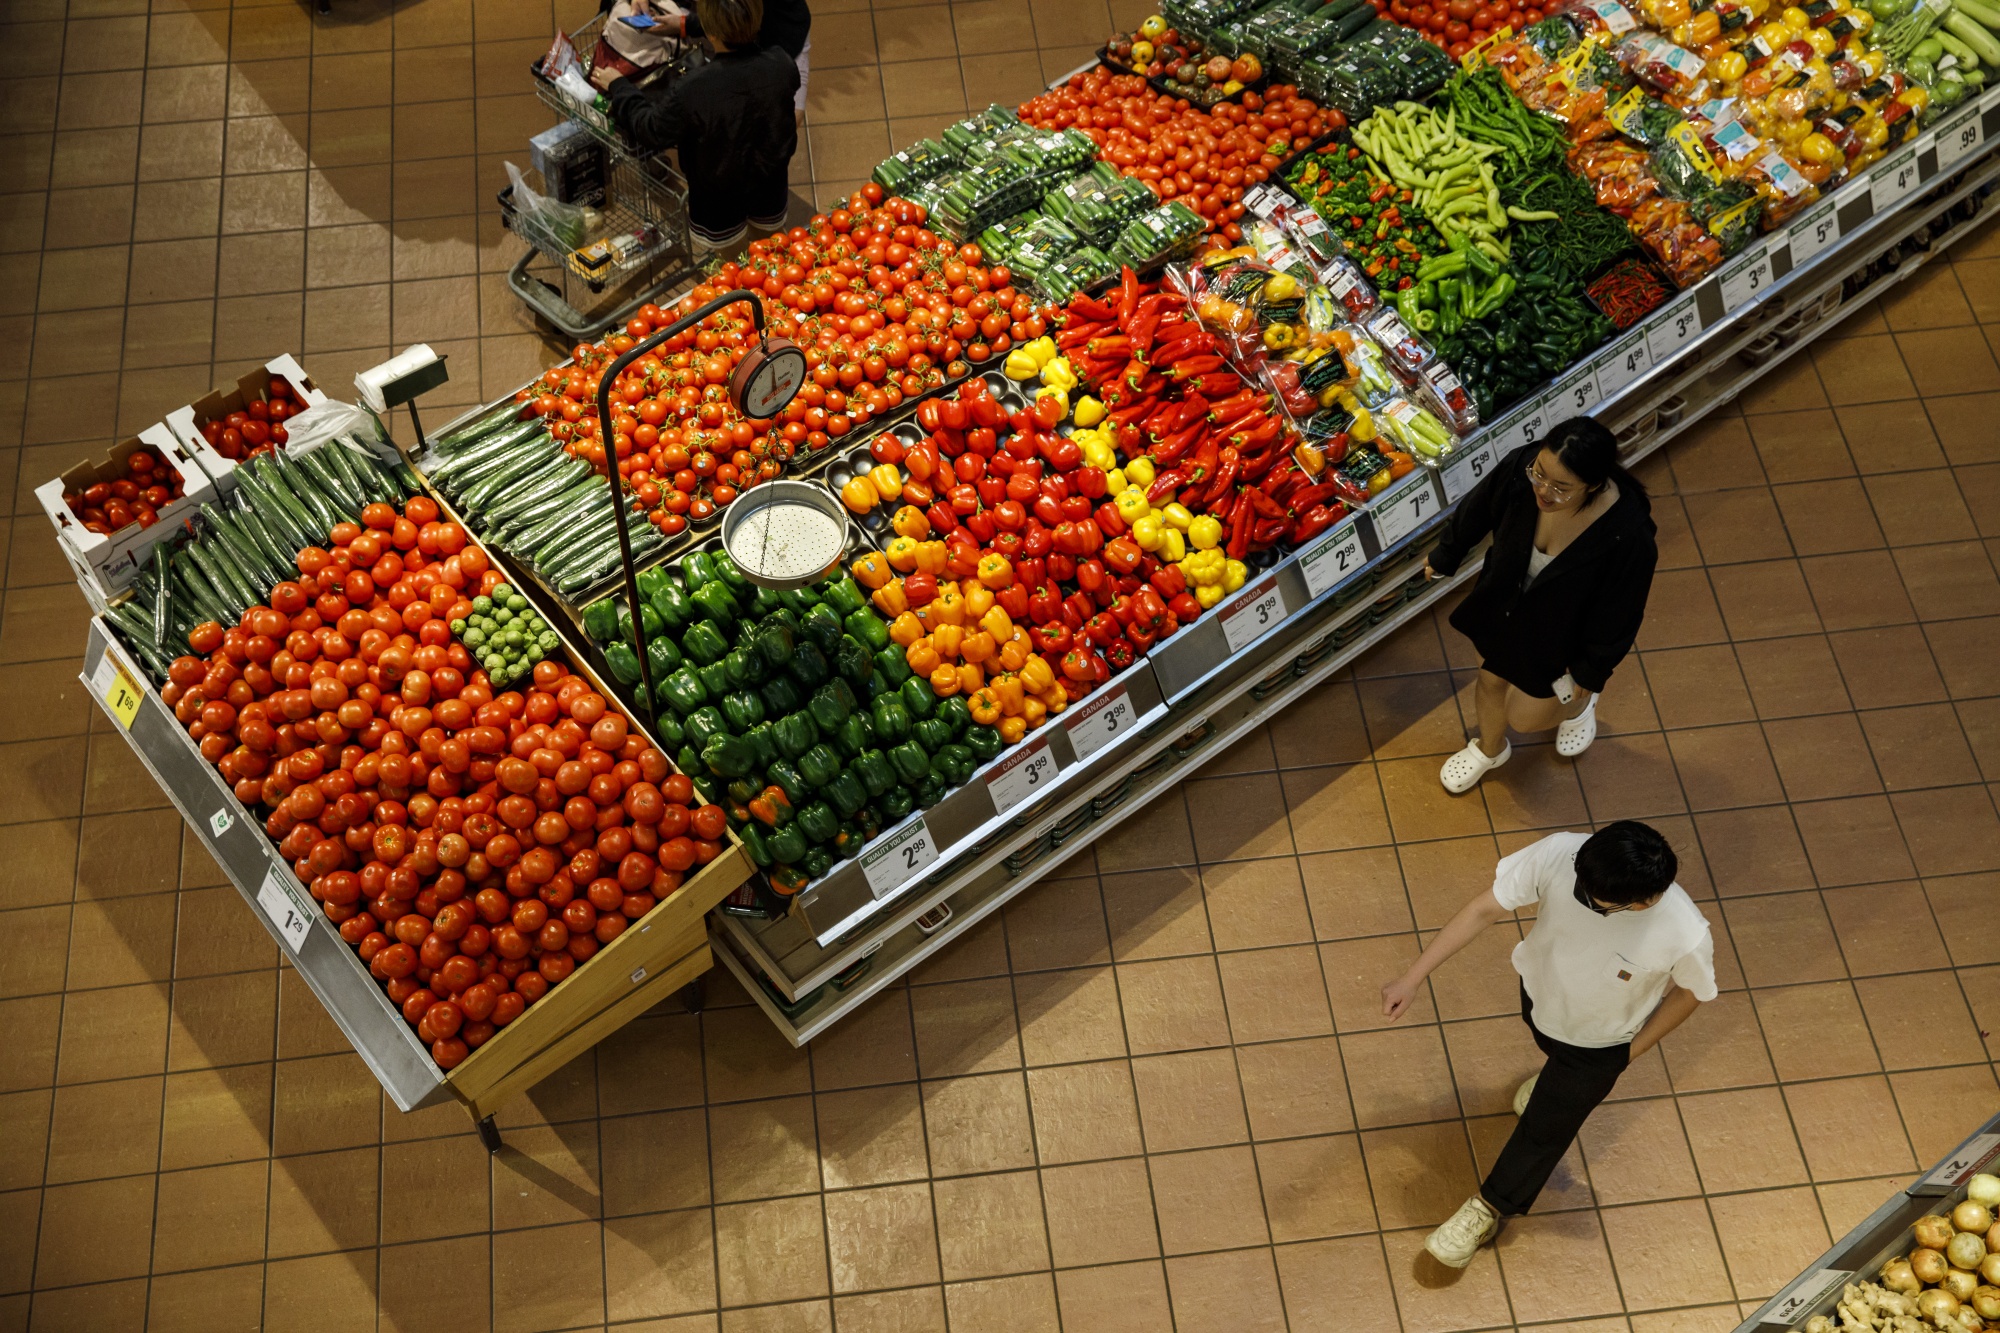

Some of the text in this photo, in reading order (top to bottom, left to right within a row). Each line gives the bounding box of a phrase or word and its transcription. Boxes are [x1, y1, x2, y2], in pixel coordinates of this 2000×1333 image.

[1959, 126, 1977, 151] .99
[1898, 165, 1914, 189] 499
[1816, 218, 1834, 244] 599
[1748, 263, 1767, 290] 399
[1676, 311, 1694, 338] 399
[1627, 347, 1644, 372] 499
[1574, 381, 1593, 408] 399
[1522, 416, 1542, 443] 599
[1470, 450, 1490, 478] 599
[1381, 477, 1424, 510] QUALITY YOU TRUST
[1409, 490, 1430, 518] 799
[1305, 529, 1350, 563] QUALITY YOU TRUST
[1335, 542, 1356, 572] 299
[1234, 588, 1262, 610] CANADA
[1255, 596, 1277, 625] 399
[116, 689, 134, 710] 169
[1081, 695, 1111, 718] CANADA
[1103, 703, 1126, 732] 399
[1002, 748, 1032, 771] CANADA
[1024, 755, 1048, 785] 399
[866, 824, 919, 863] QUALITY YOU TRUST
[902, 838, 926, 870] 299
[273, 870, 309, 917] QUALITY YOU TRUST
[284, 909, 304, 933] 129
[1779, 1297, 1805, 1318] 299
